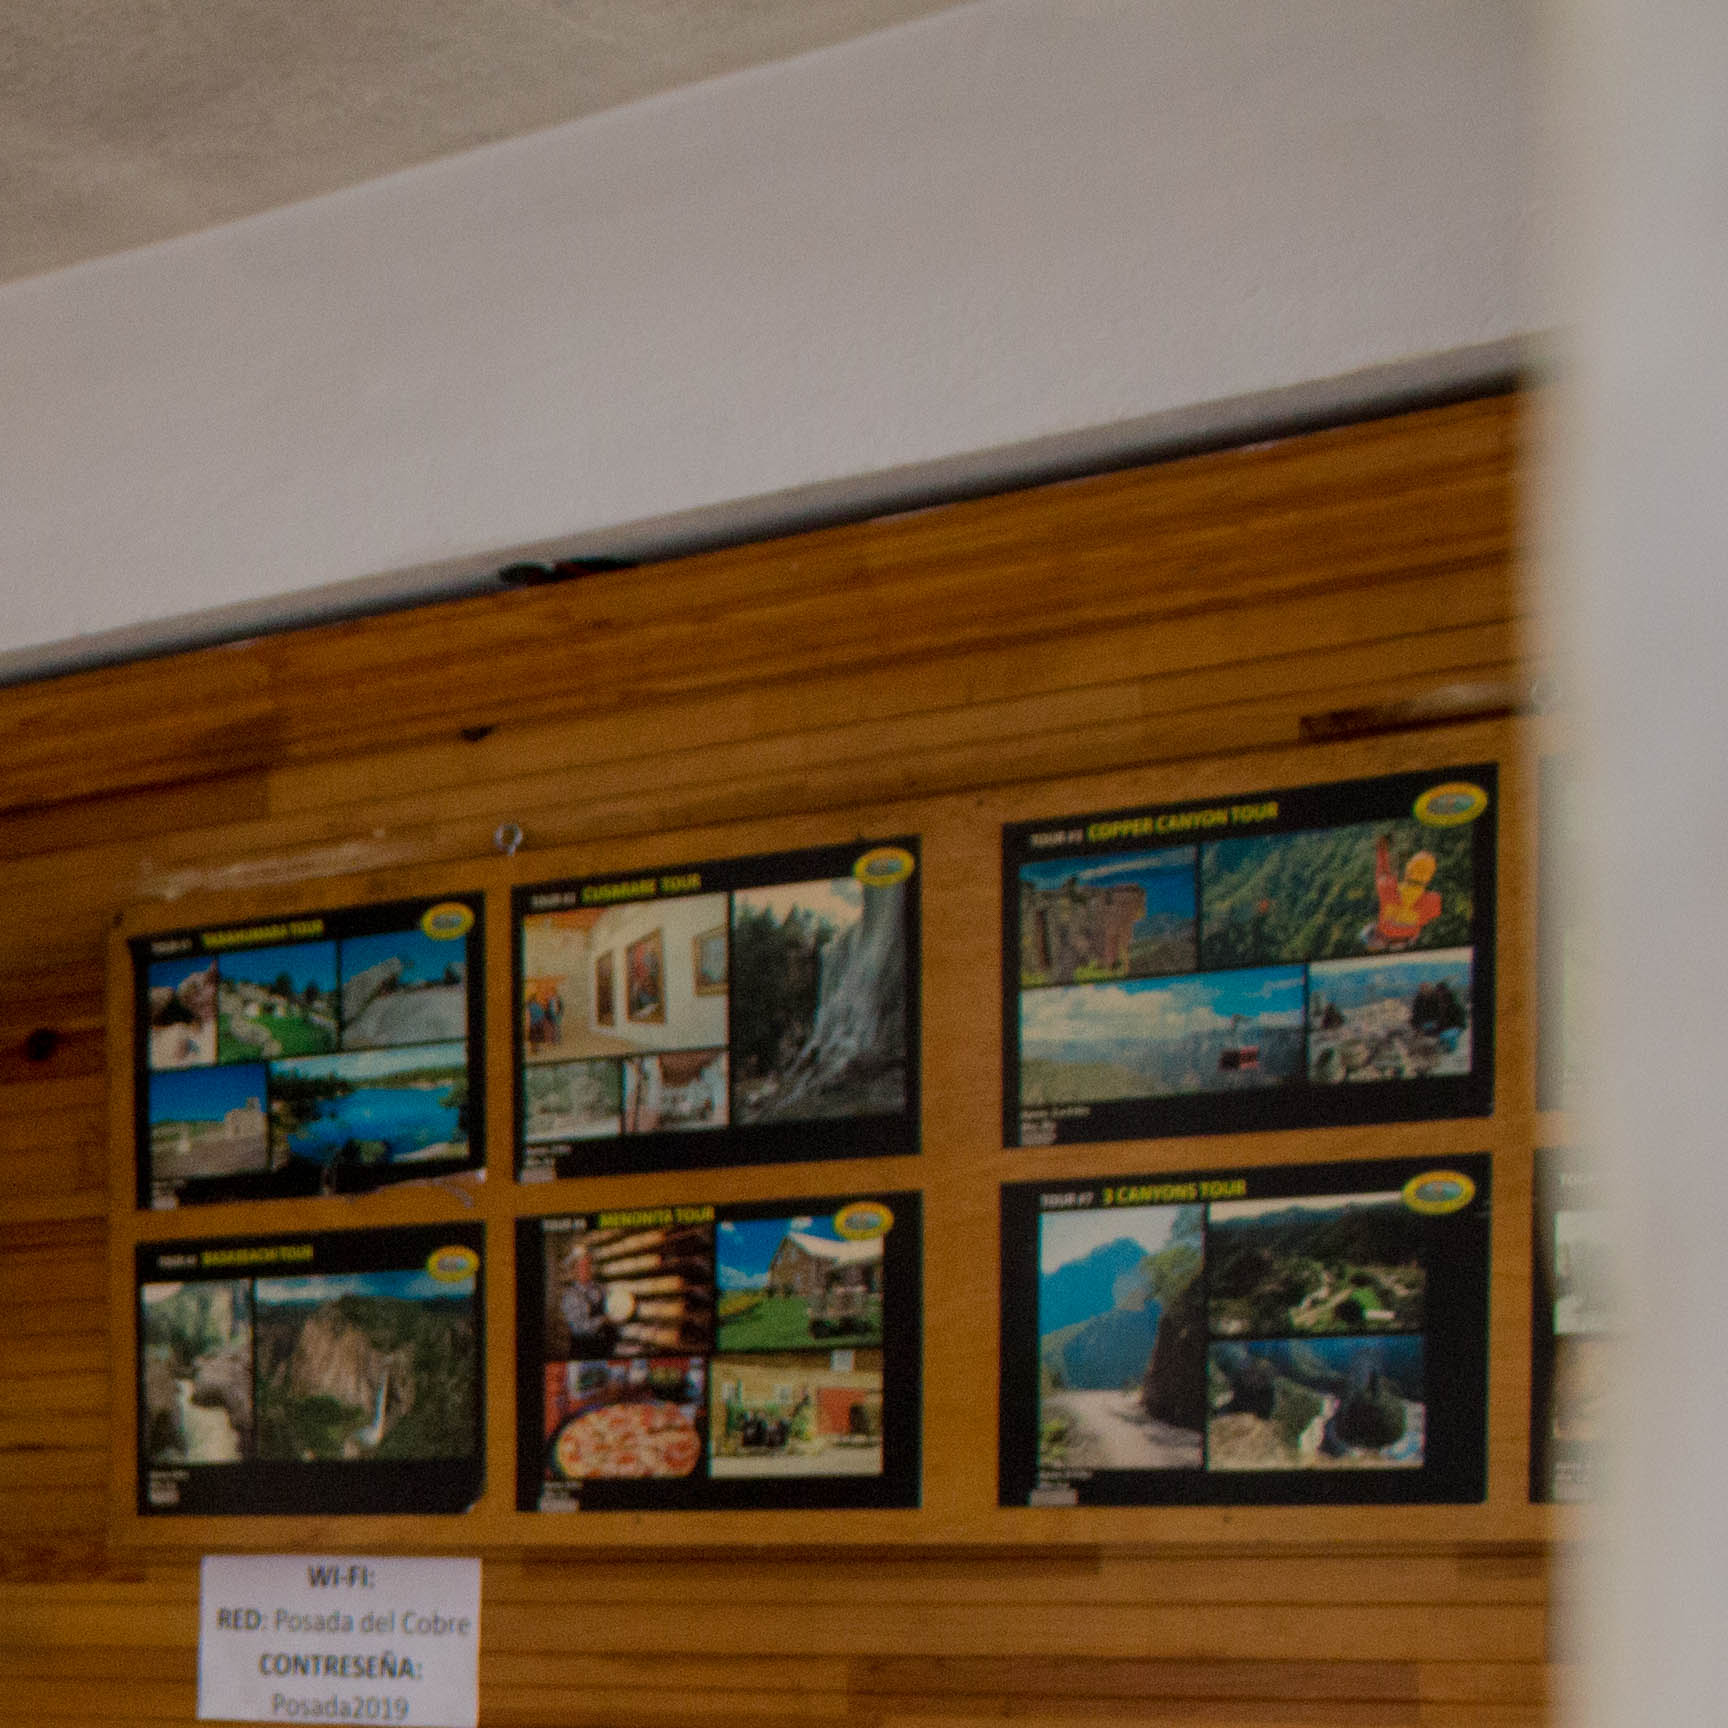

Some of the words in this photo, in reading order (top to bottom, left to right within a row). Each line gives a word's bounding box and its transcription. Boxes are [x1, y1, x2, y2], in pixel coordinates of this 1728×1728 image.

[1086, 816, 1153, 843] COPPER
[1155, 808, 1229, 835] CANYON
[1231, 801, 1279, 824] TOUR
[659, 872, 702, 893] TOUR
[289, 918, 325, 938] TOUR
[1039, 1192, 1077, 1209] TOUR
[1101, 1187, 1114, 1206] 3
[1115, 1181, 1198, 1205] CANYONS
[1199, 1178, 1247, 1200] TOUR
[598, 1208, 673, 1229] MENONITA
[674, 1205, 715, 1223] TOUR
[279, 1243, 314, 1262] TOUR
[308, 1564, 376, 1589] WI-FI:
[217, 1607, 268, 1632] RED:
[274, 1607, 354, 1634] Posada
[359, 1609, 395, 1634] del
[401, 1609, 472, 1637] Cobre
[271, 1692, 411, 1722] Posada2019
